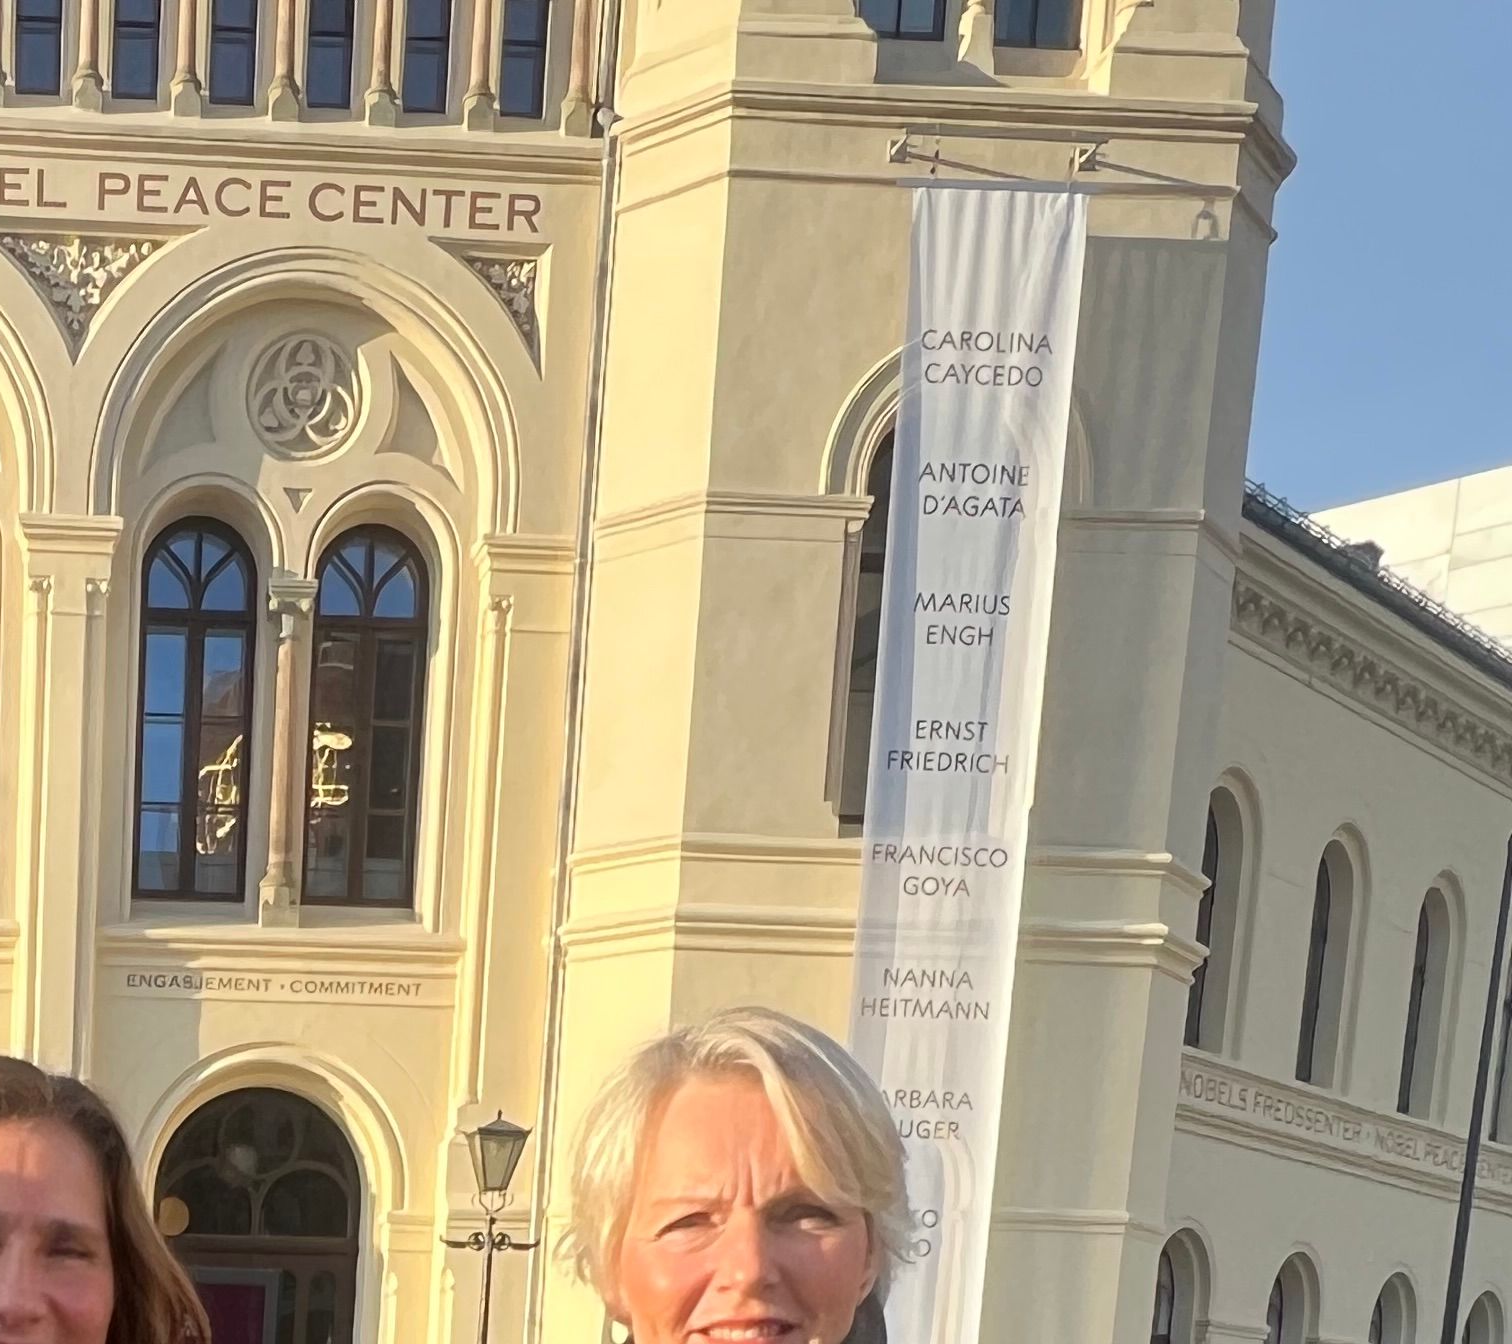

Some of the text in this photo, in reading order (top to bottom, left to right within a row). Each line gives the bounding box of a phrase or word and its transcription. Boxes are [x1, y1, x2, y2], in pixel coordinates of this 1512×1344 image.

[97, 172, 292, 220] PEACE
[308, 182, 542, 233] CENTER
[921, 328, 1054, 355] CAROLINA
[924, 362, 1044, 388] CAYCEDO
[918, 462, 1031, 487] ANTOINE
[922, 495, 1026, 519] D'AGATA
[913, 592, 1011, 616] MARIUS
[926, 624, 995, 647] ENGH
[915, 719, 989, 743] ERNST
[887, 749, 1009, 775] FRIEDRICH
[871, 843, 1008, 868] FRANCISCO
[902, 876, 971, 899] GOYA
[126, 972, 423, 997] ENGASJEMENT COMMITMENT
[882, 967, 974, 991] NANNA
[860, 996, 990, 1021] HEITMANN
[899, 1118, 961, 1141] UGER
